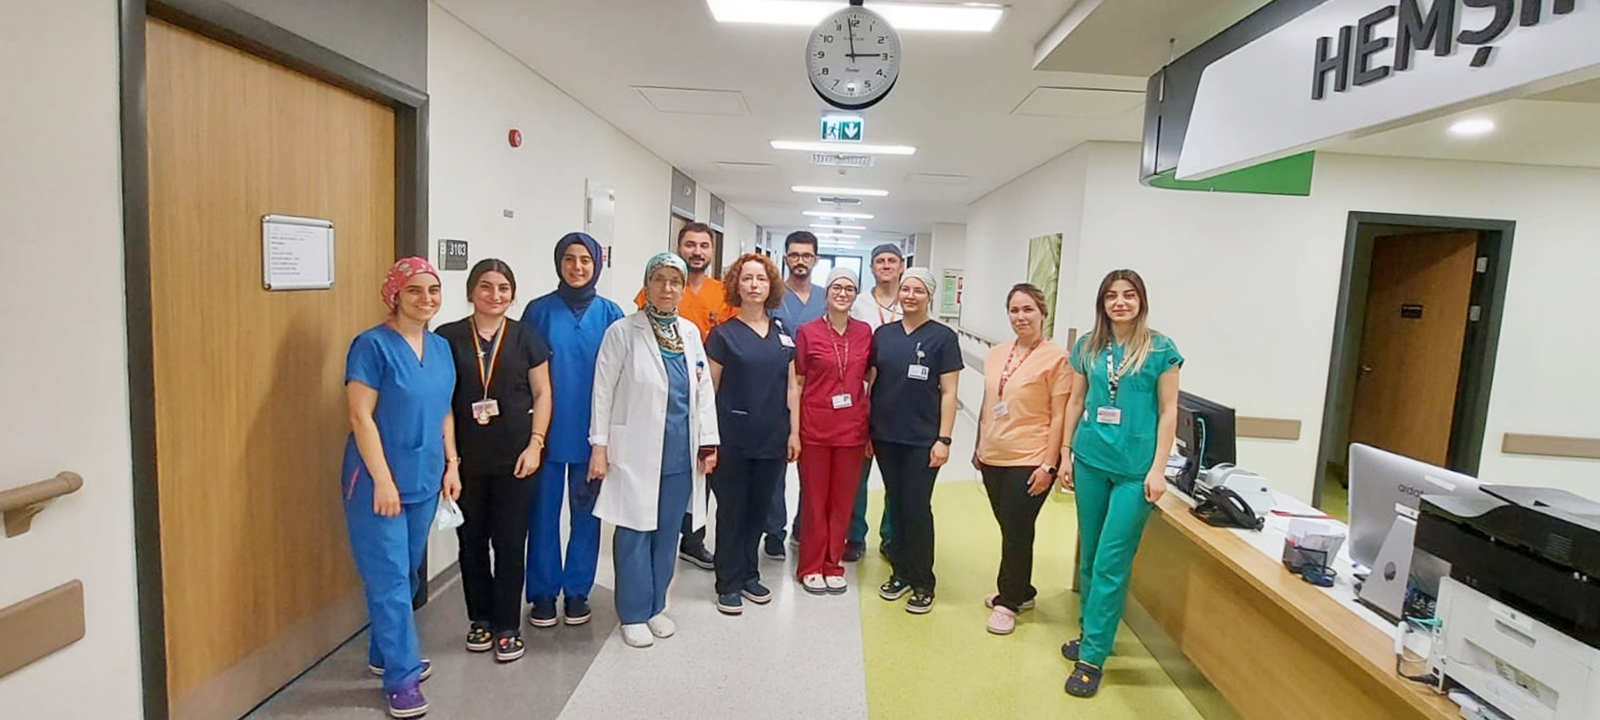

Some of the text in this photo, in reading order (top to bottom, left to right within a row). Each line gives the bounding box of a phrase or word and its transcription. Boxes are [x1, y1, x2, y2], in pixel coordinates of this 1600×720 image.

[823, 35, 834, 43] 10
[877, 36, 885, 44] 2
[1311, 0, 1575, 100] HEMŞ
[817, 51, 825, 59] 9
[881, 53, 888, 61] 3
[822, 67, 829, 76] 8
[876, 68, 883, 76] 4
[833, 79, 840, 87] 7
[864, 80, 871, 88] 5
[449, 243, 466, 256] 3103
